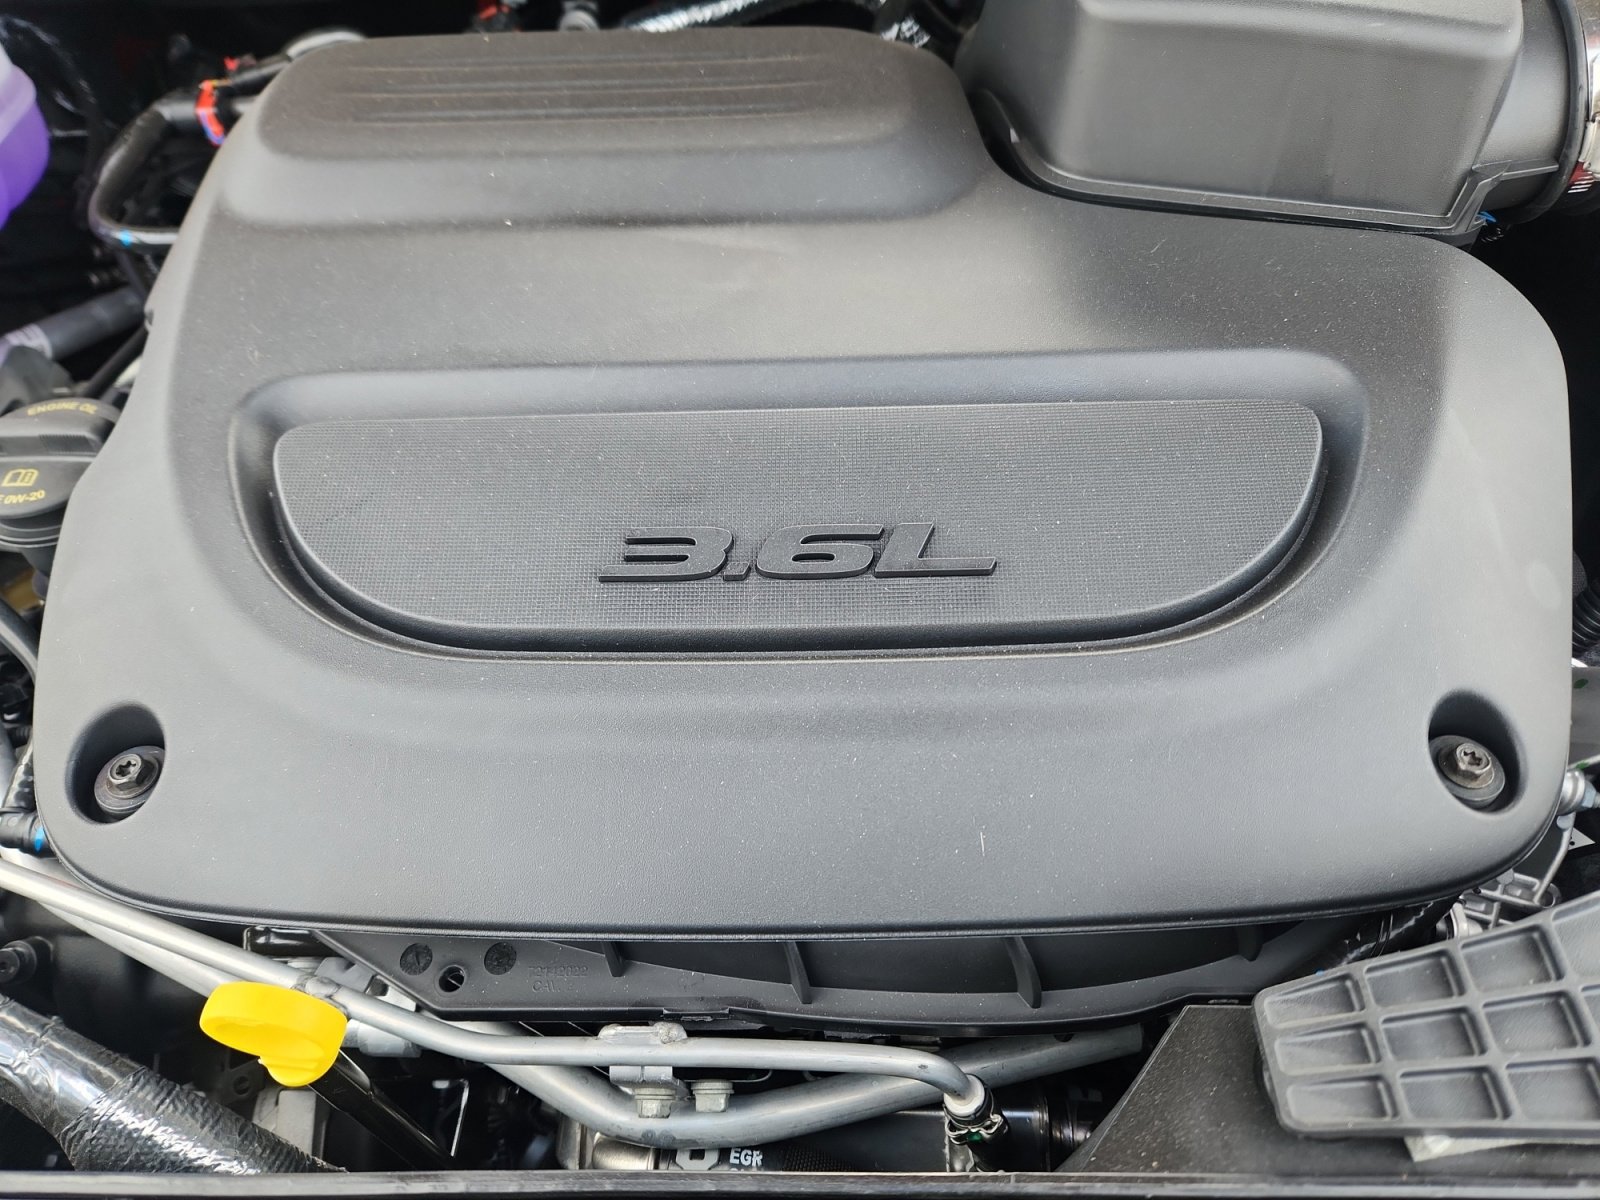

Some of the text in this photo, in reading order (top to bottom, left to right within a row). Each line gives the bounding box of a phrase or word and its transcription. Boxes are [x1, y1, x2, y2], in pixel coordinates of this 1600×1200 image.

[27, 401, 78, 416] ENGINE
[4, 489, 46, 505] 0W-20
[598, 522, 998, 583] 3.6L
[729, 1147, 764, 1167] EGR
